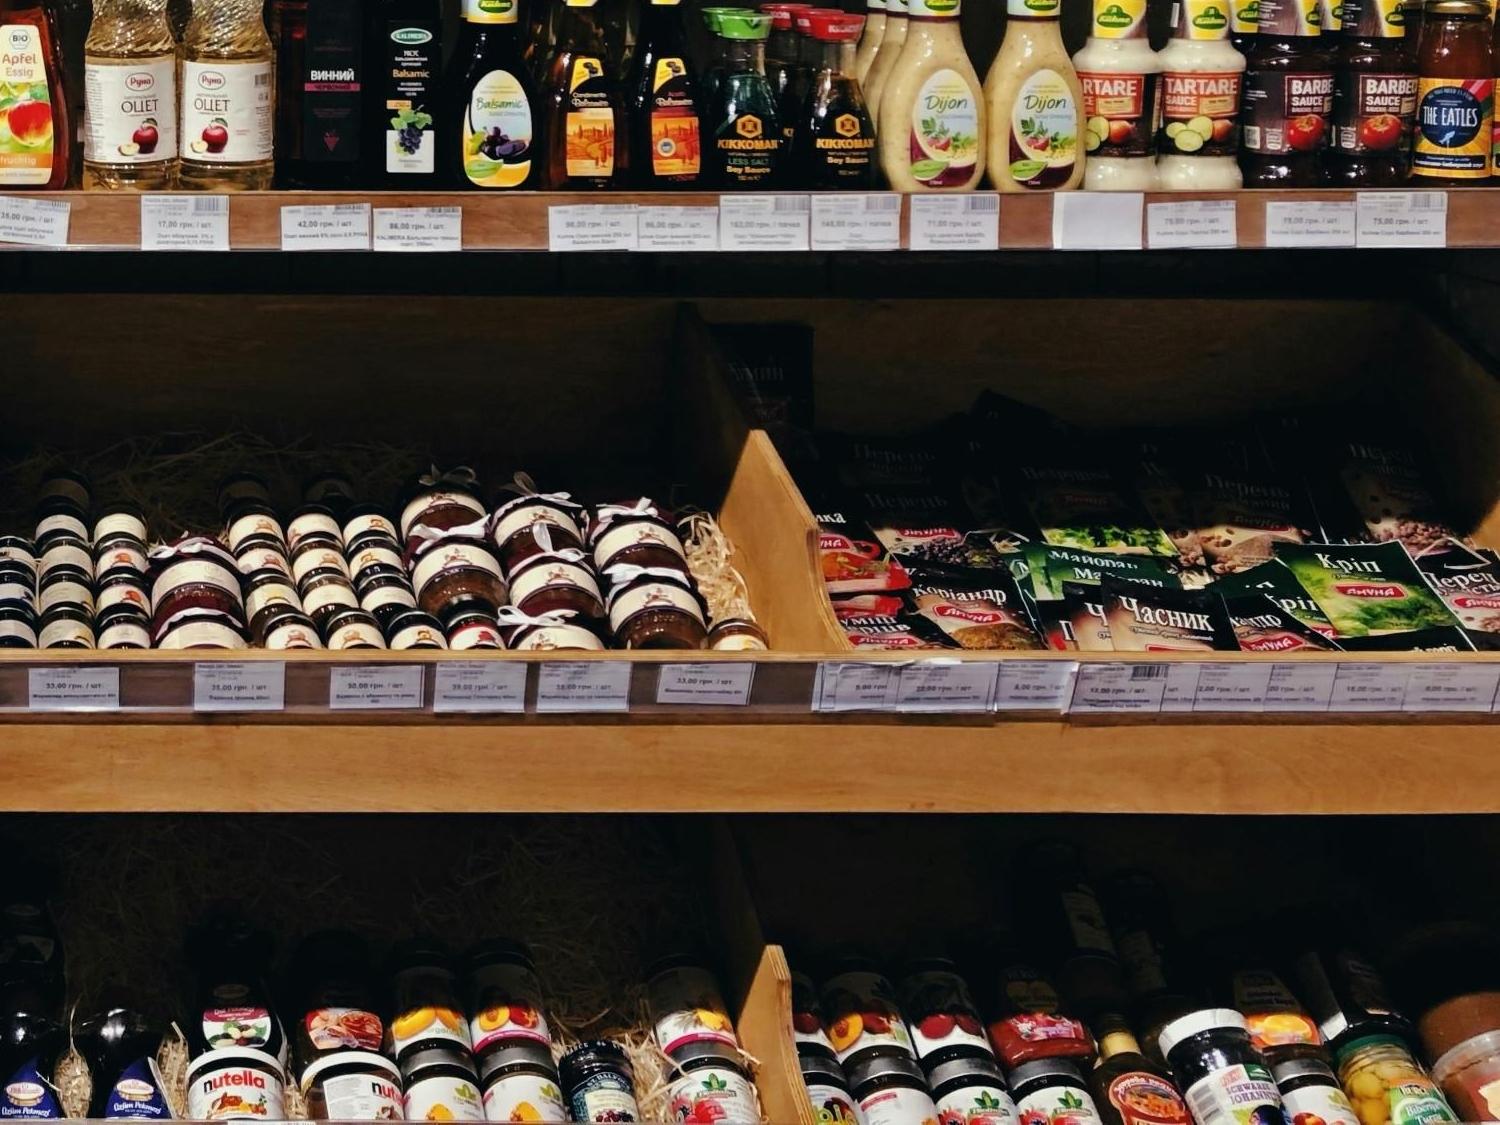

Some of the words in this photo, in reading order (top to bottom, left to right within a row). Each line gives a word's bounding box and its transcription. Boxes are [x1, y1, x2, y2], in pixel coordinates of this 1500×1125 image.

[12, 35, 28, 43] BIO
[2, 53, 36, 67] Apfel
[6, 67, 34, 79] Essig
[311, 69, 354, 81] ВИННИЙ
[392, 69, 430, 79] Balsamic
[1166, 79, 1237, 95] TARTARE
[121, 99, 159, 113] ОЦЕТ
[194, 98, 230, 112] ОЦЕТ
[476, 97, 523, 111] Balsamic
[925, 94, 968, 112] Dijon
[1024, 96, 1066, 110] Dijon
[1166, 97, 1197, 106] SAUCE
[1292, 97, 1323, 106] SAUCE
[1423, 106, 1438, 124] THE
[1441, 107, 1478, 127] EATLES
[718, 139, 778, 150] KIKKOMAN
[816, 138, 874, 149] KIKKOMAN
[0, 155, 37, 166] fruchtig
[728, 157, 746, 165] LESS
[827, 156, 843, 164] Soy
[1315, 553, 1382, 573] Кріп
[912, 584, 1008, 603] Коріандр
[1119, 595, 1215, 632] Часник
[203, 1071, 266, 1094] nutella
